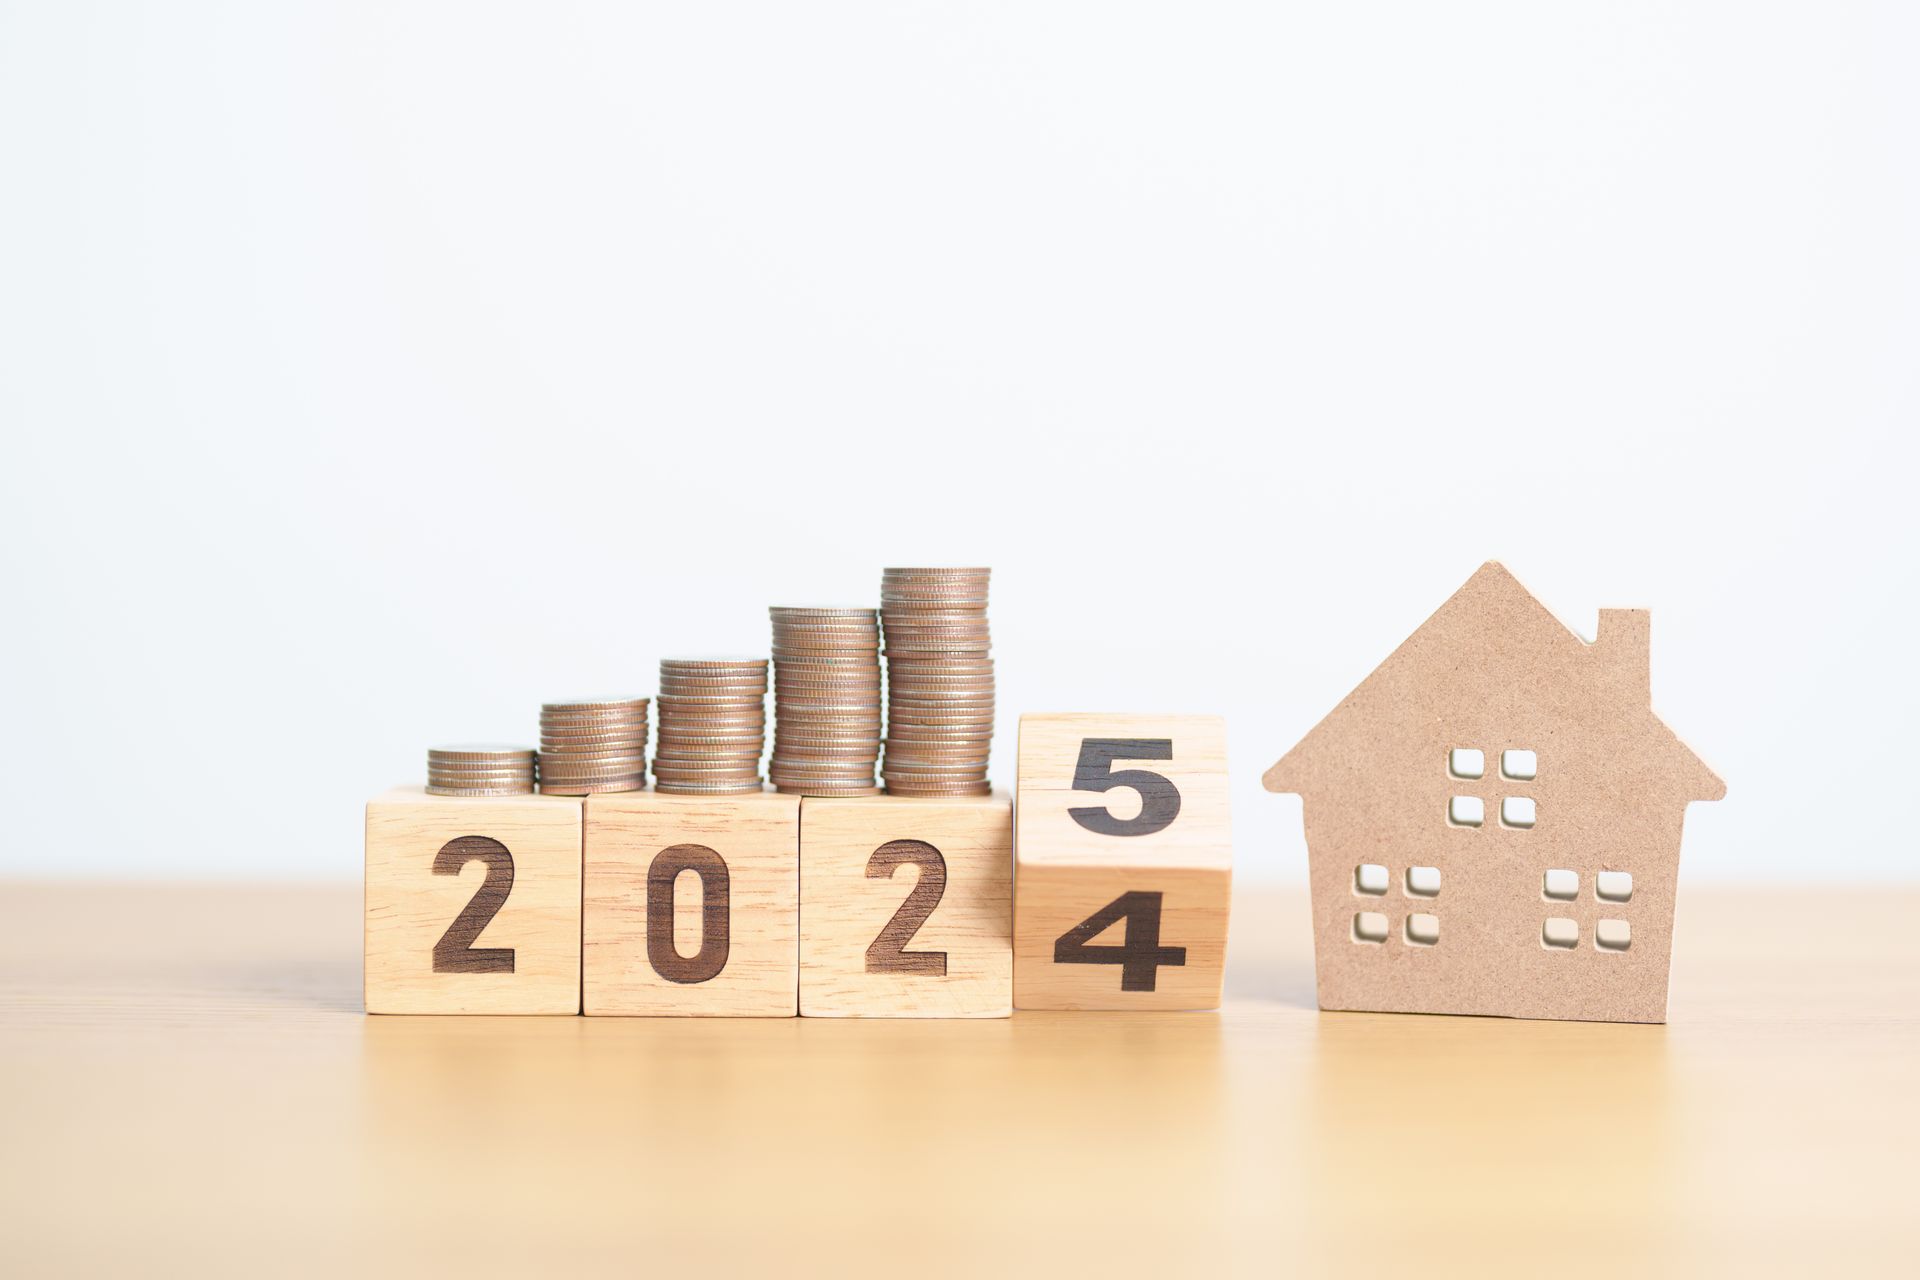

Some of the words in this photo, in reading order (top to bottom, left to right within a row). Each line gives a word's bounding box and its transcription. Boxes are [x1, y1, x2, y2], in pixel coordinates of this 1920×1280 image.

[1067, 738, 1181, 837] 5
[432, 835, 515, 974] 2
[647, 844, 730, 984] 0
[865, 839, 948, 977] 2
[1054, 891, 1186, 992] 4
